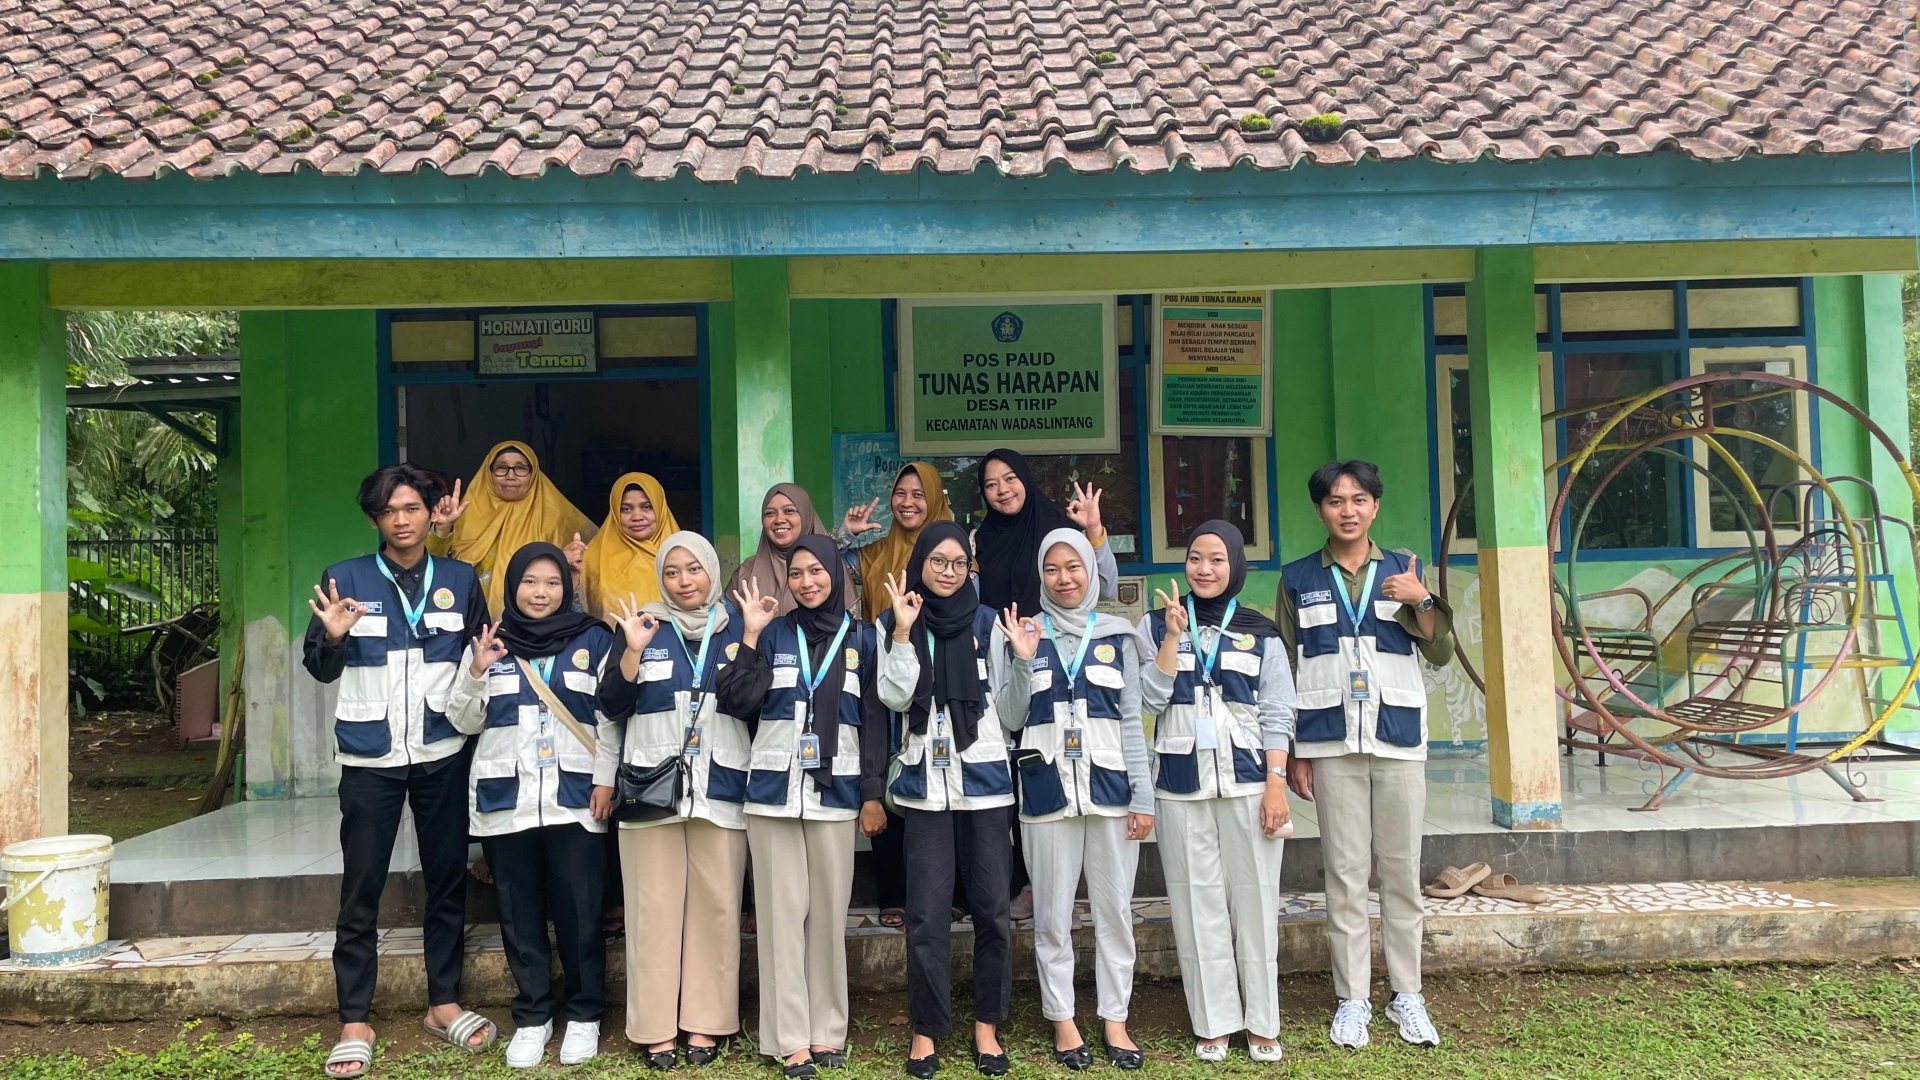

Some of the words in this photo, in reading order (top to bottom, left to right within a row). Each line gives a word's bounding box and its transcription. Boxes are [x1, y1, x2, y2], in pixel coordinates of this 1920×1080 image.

[481, 320, 549, 336] HORMATI
[551, 318, 592, 335] GURU
[516, 351, 586, 368] Teman
[963, 353, 999, 367] POS
[1006, 352, 1055, 366] PAUD
[918, 372, 989, 395] TUNAS
[997, 370, 1098, 394] HARAPAN
[967, 399, 1010, 411] DESA
[1014, 398, 1057, 411] TIRIP
[926, 418, 998, 431] KECAMATAN
[1002, 416, 1093, 430] WADASLINTANG
